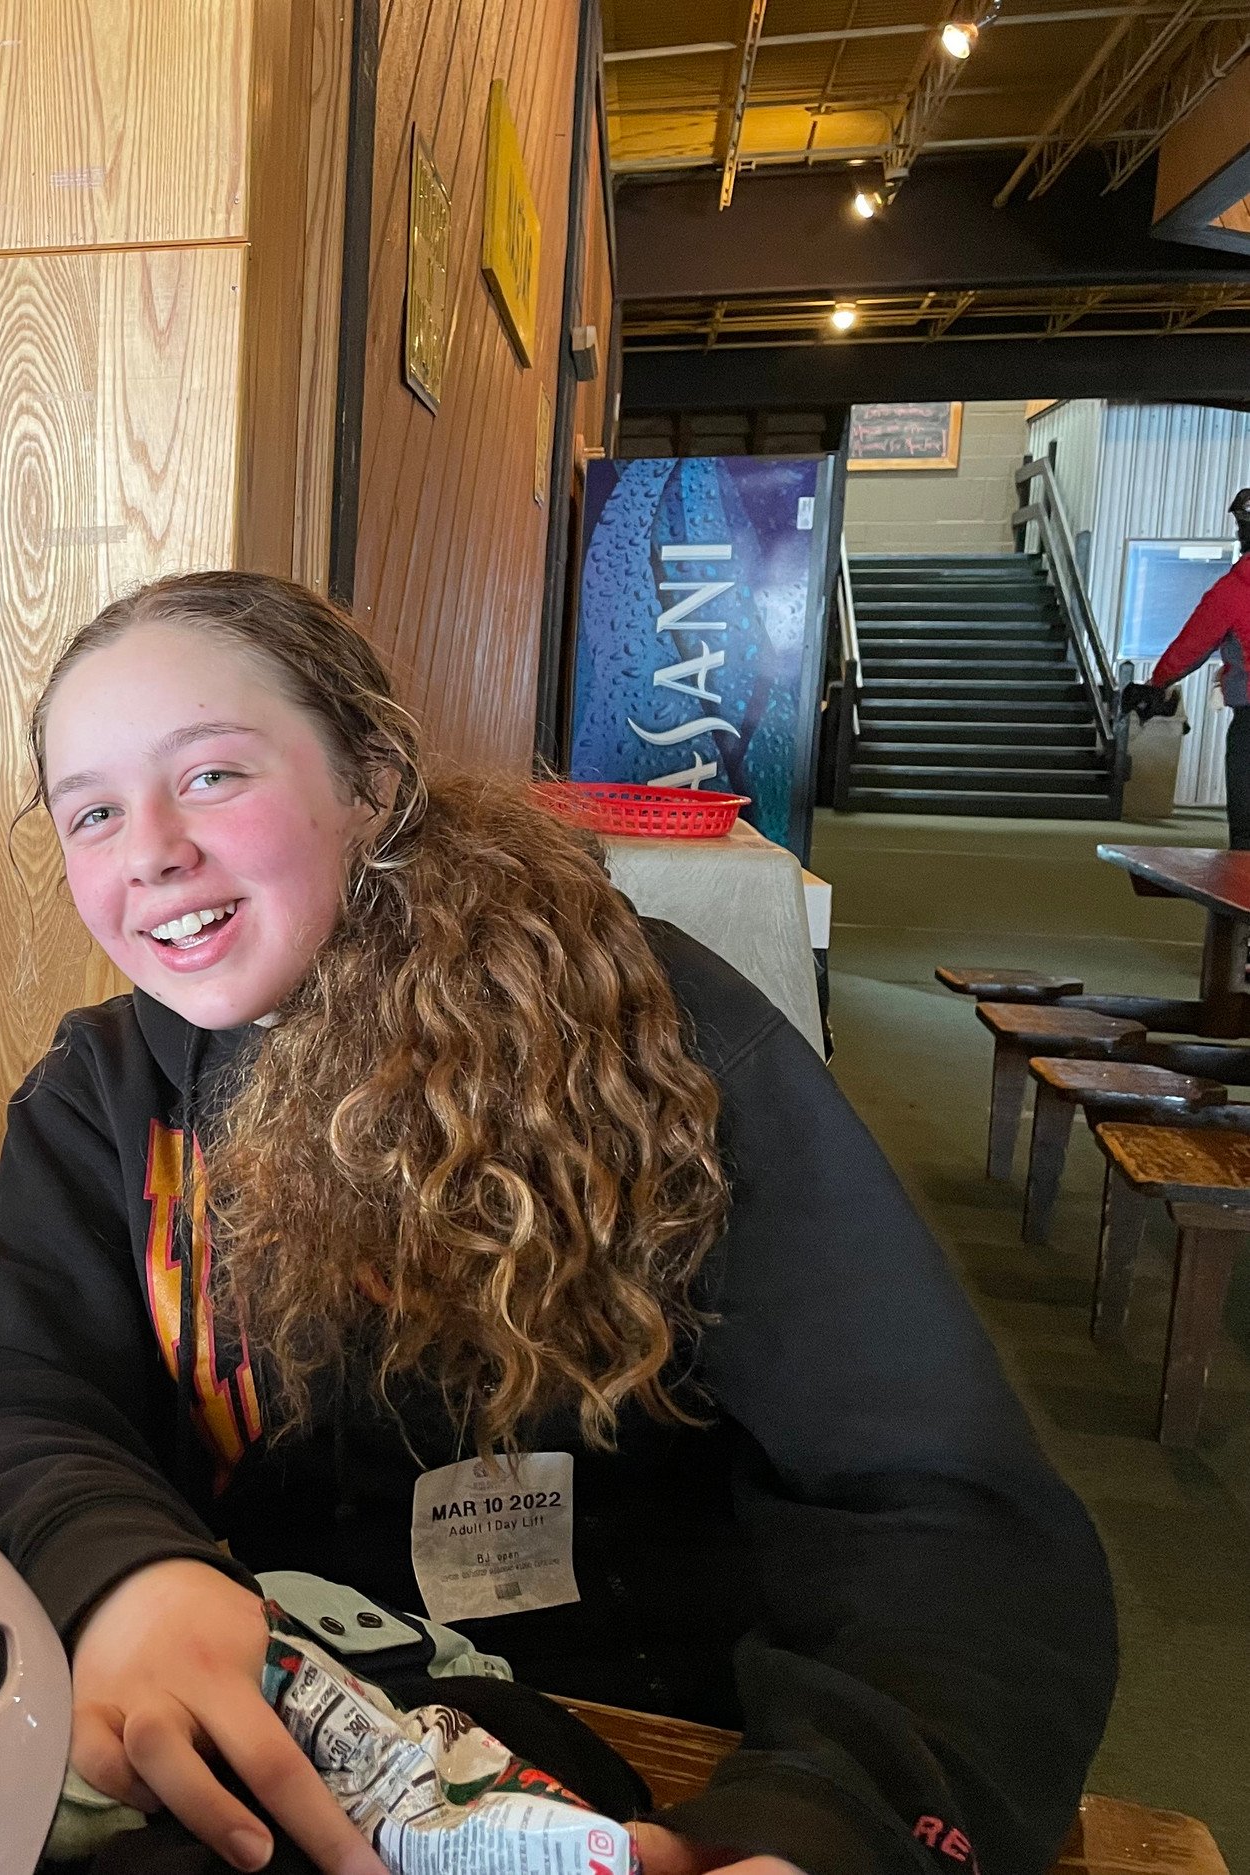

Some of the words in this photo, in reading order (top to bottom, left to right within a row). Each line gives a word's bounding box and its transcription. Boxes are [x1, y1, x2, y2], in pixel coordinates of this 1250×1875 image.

[628, 544, 741, 790] ASANI
[432, 1500, 477, 1522] MAR
[485, 1497, 503, 1514] 10
[509, 1491, 561, 1511] 2022
[449, 1522, 482, 1537] Adult
[487, 1521, 492, 1532] 1
[495, 1519, 517, 1532] Day
[522, 1515, 544, 1528] Lift
[291, 1665, 318, 1702] Facts
